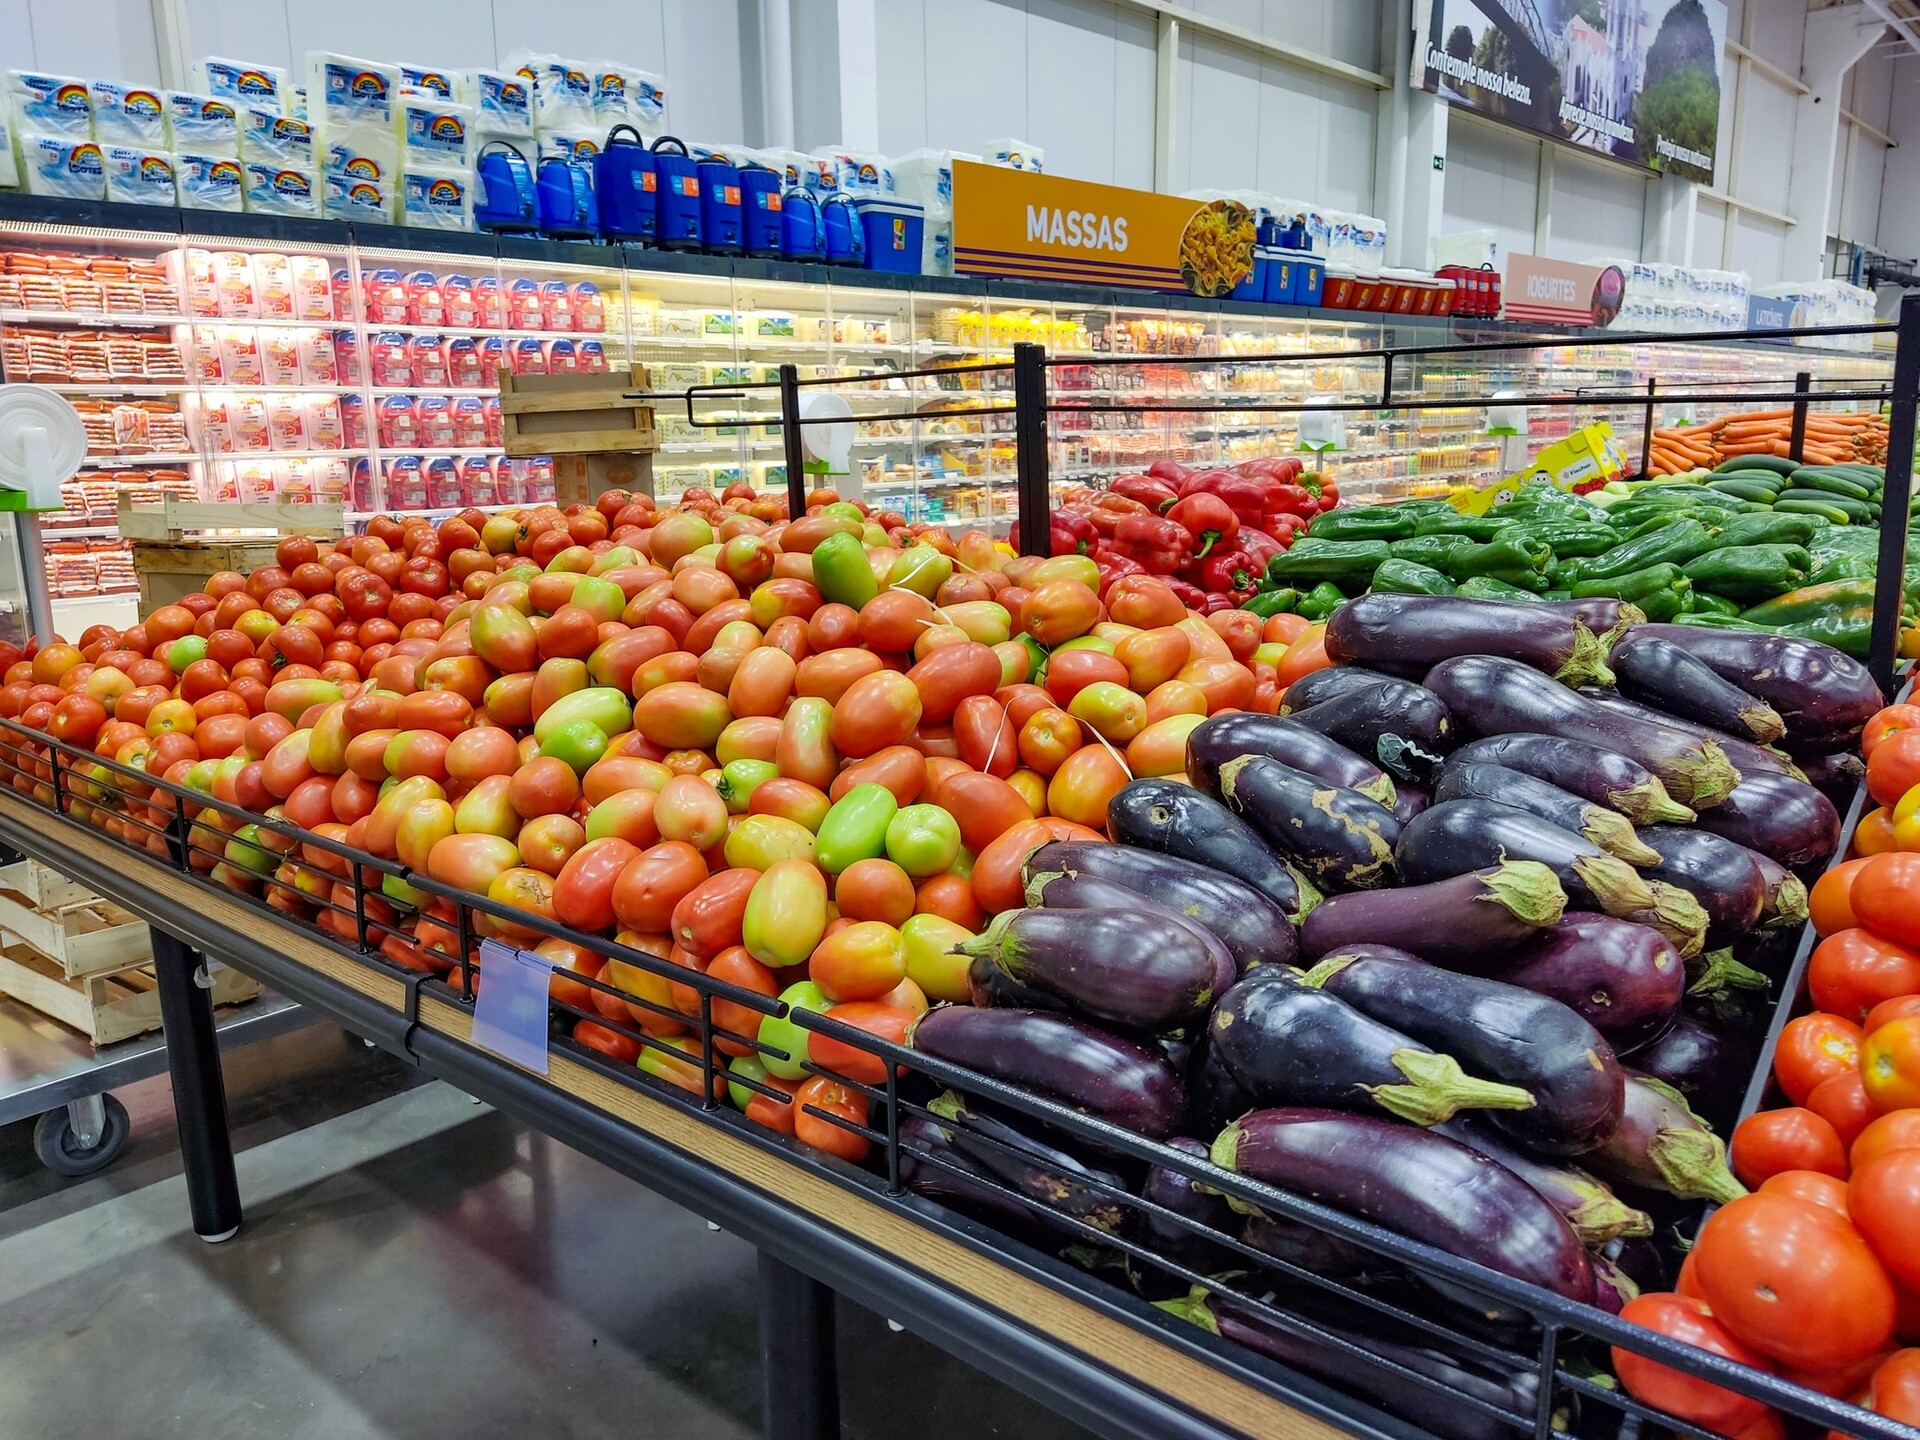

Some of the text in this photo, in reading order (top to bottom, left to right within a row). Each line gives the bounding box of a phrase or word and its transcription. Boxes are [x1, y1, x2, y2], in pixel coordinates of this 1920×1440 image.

[1424, 41, 1532, 105] Contemple nossa beleza.
[1558, 96, 1585, 125] Aprecie
[1585, 111, 1605, 134] nossa
[1026, 203, 1129, 253] MASSAS
[1526, 273, 1576, 303] IOGURTES
[1569, 462, 1592, 476] Fischer
